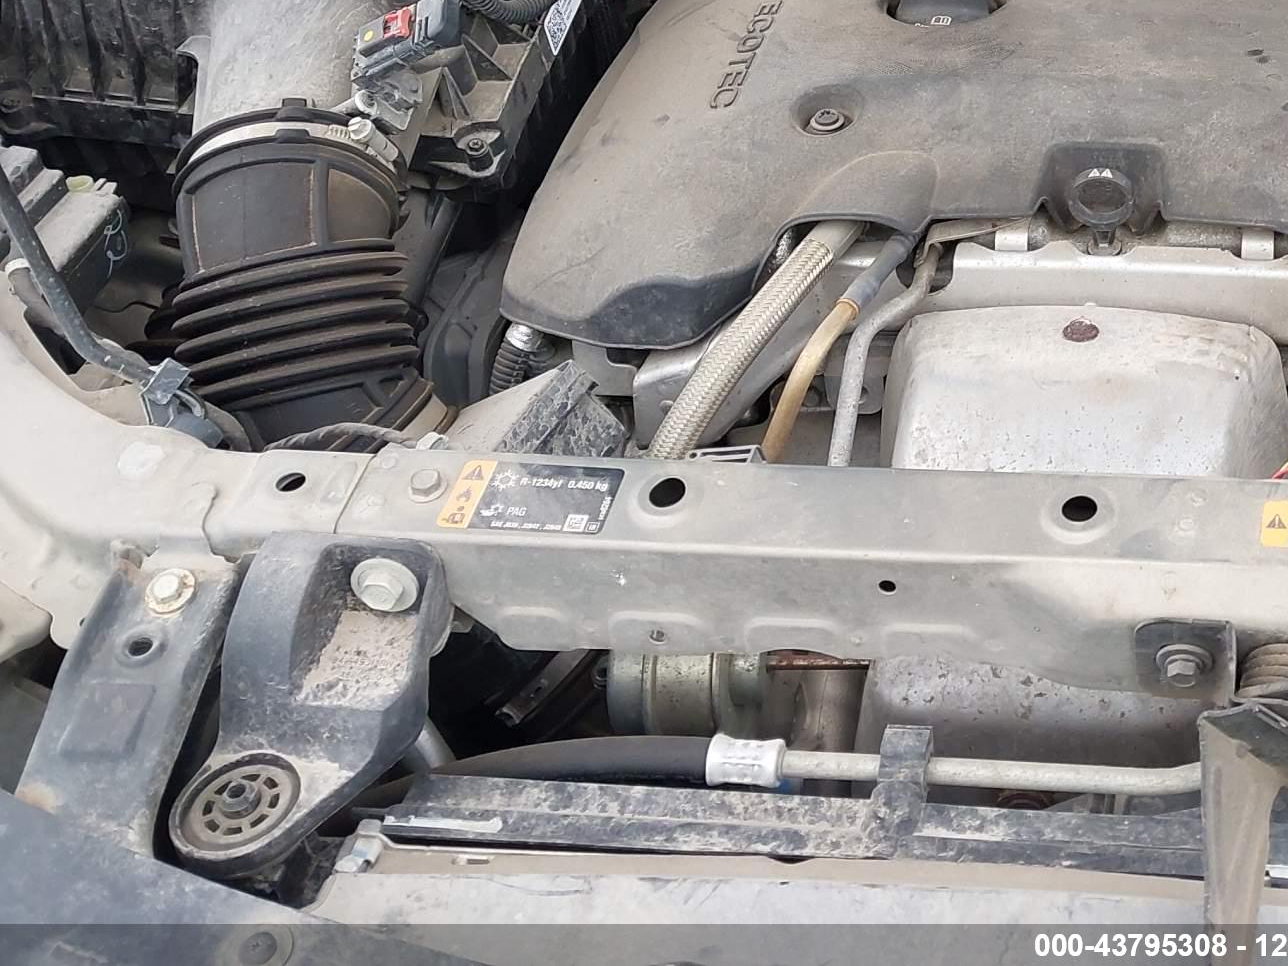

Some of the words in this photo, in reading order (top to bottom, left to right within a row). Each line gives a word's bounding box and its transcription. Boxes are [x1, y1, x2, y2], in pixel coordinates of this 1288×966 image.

[709, 0, 784, 110] ECOTEC
[567, 479, 594, 490] 0.450
[596, 481, 609, 492] kg
[506, 506, 528, 516] PAG
